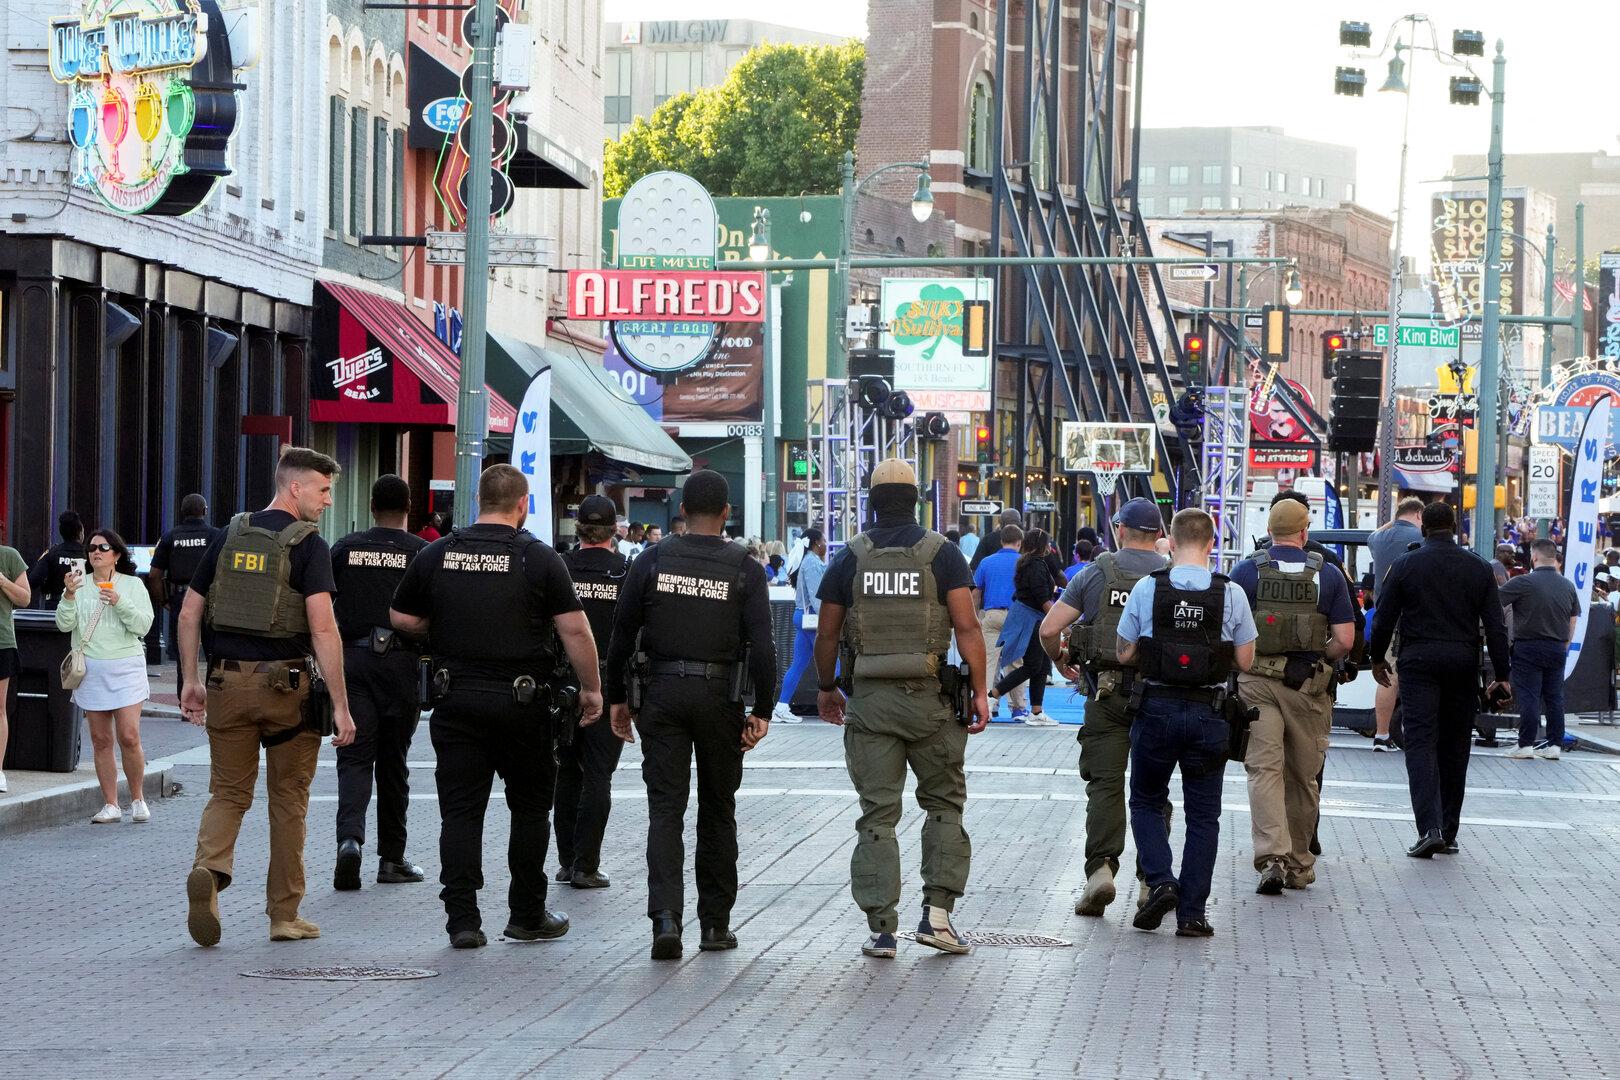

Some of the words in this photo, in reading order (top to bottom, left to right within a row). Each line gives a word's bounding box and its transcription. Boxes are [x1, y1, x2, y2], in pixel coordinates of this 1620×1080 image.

[437, 104, 466, 120] FO
[1444, 199, 1514, 219] SLOS
[623, 257, 656, 268] LIVE
[662, 256, 710, 268] MUSIC
[1175, 268, 1188, 276] ONE
[1190, 268, 1205, 276] WAY
[576, 272, 761, 316] ALFRED'S
[622, 322, 667, 334] GREAT
[673, 323, 708, 334] FOOD
[1377, 327, 1389, 343] B.
[1402, 328, 1427, 346] King
[1429, 328, 1457, 346] Blvd.
[894, 362, 950, 373] SOUTHERN
[344, 387, 380, 400] BEALE
[728, 425, 763, 437] 00183
[1532, 465, 1555, 478] 20
[173, 538, 207, 548] POLICE
[233, 552, 265, 571] FBI
[349, 551, 381, 560] MEMPHIS
[381, 553, 407, 562] POLICE
[444, 551, 479, 563] MEMPHIS
[480, 554, 510, 564] POLICE
[348, 558, 363, 566] NMS
[363, 559, 382, 567] TASK
[383, 560, 406, 569] FORCE
[443, 560, 460, 570] NMS
[461, 562, 481, 571] TASK
[482, 563, 509, 572] FORCE
[592, 583, 618, 593] POLICE
[657, 573, 697, 587] MEMPHIS
[698, 578, 729, 591] POLICE
[863, 571, 920, 595] POLICE
[593, 591, 617, 600] FORCE
[656, 582, 675, 593] NMS
[676, 585, 698, 597] TASK
[699, 588, 728, 600] FORCE
[1262, 580, 1313, 601] POLICE
[1176, 607, 1203, 619] ATF
[1174, 620, 1198, 629] 5479
